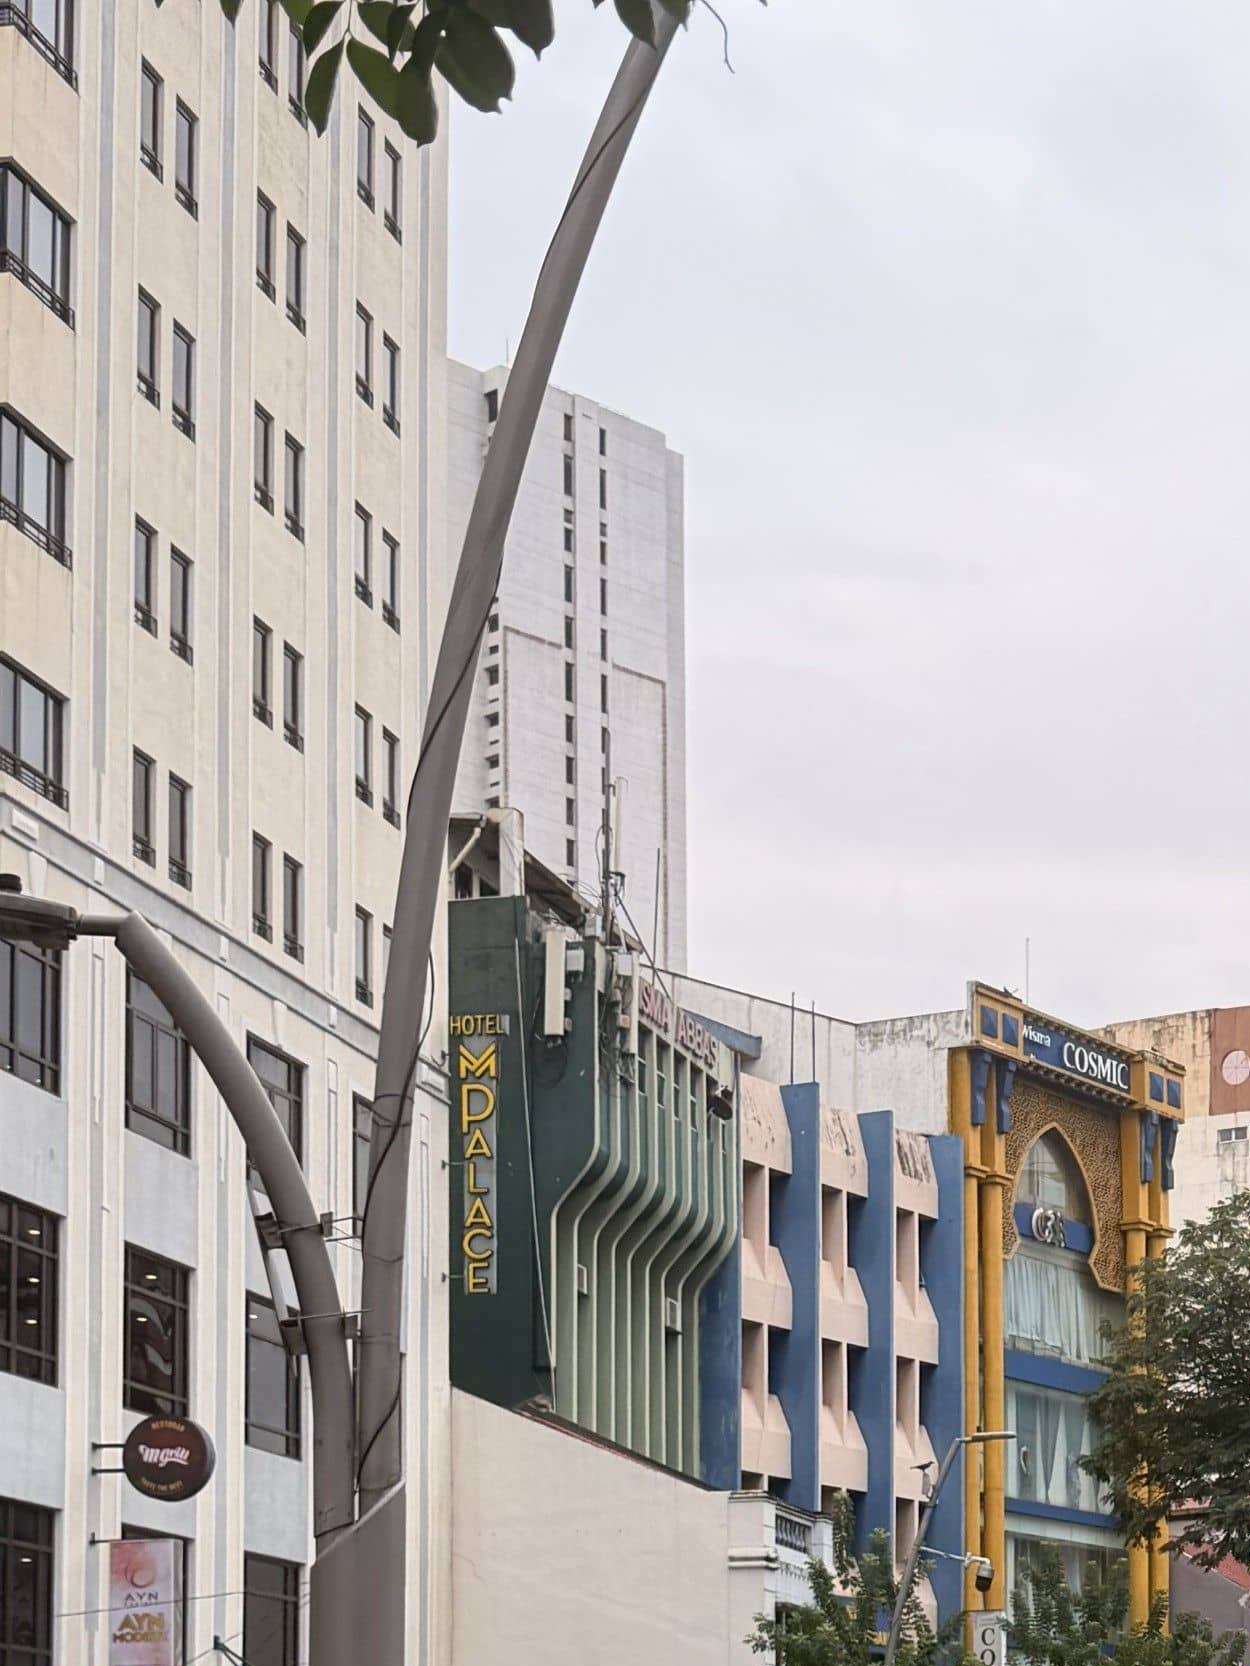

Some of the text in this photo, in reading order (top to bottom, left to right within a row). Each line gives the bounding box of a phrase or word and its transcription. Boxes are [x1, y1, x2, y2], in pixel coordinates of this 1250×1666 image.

[450, 1014, 504, 1036] HOTEL
[1063, 1041, 1129, 1090] COSMIC
[125, 1591, 159, 1602] AYN
[117, 1612, 165, 1632] AYN
